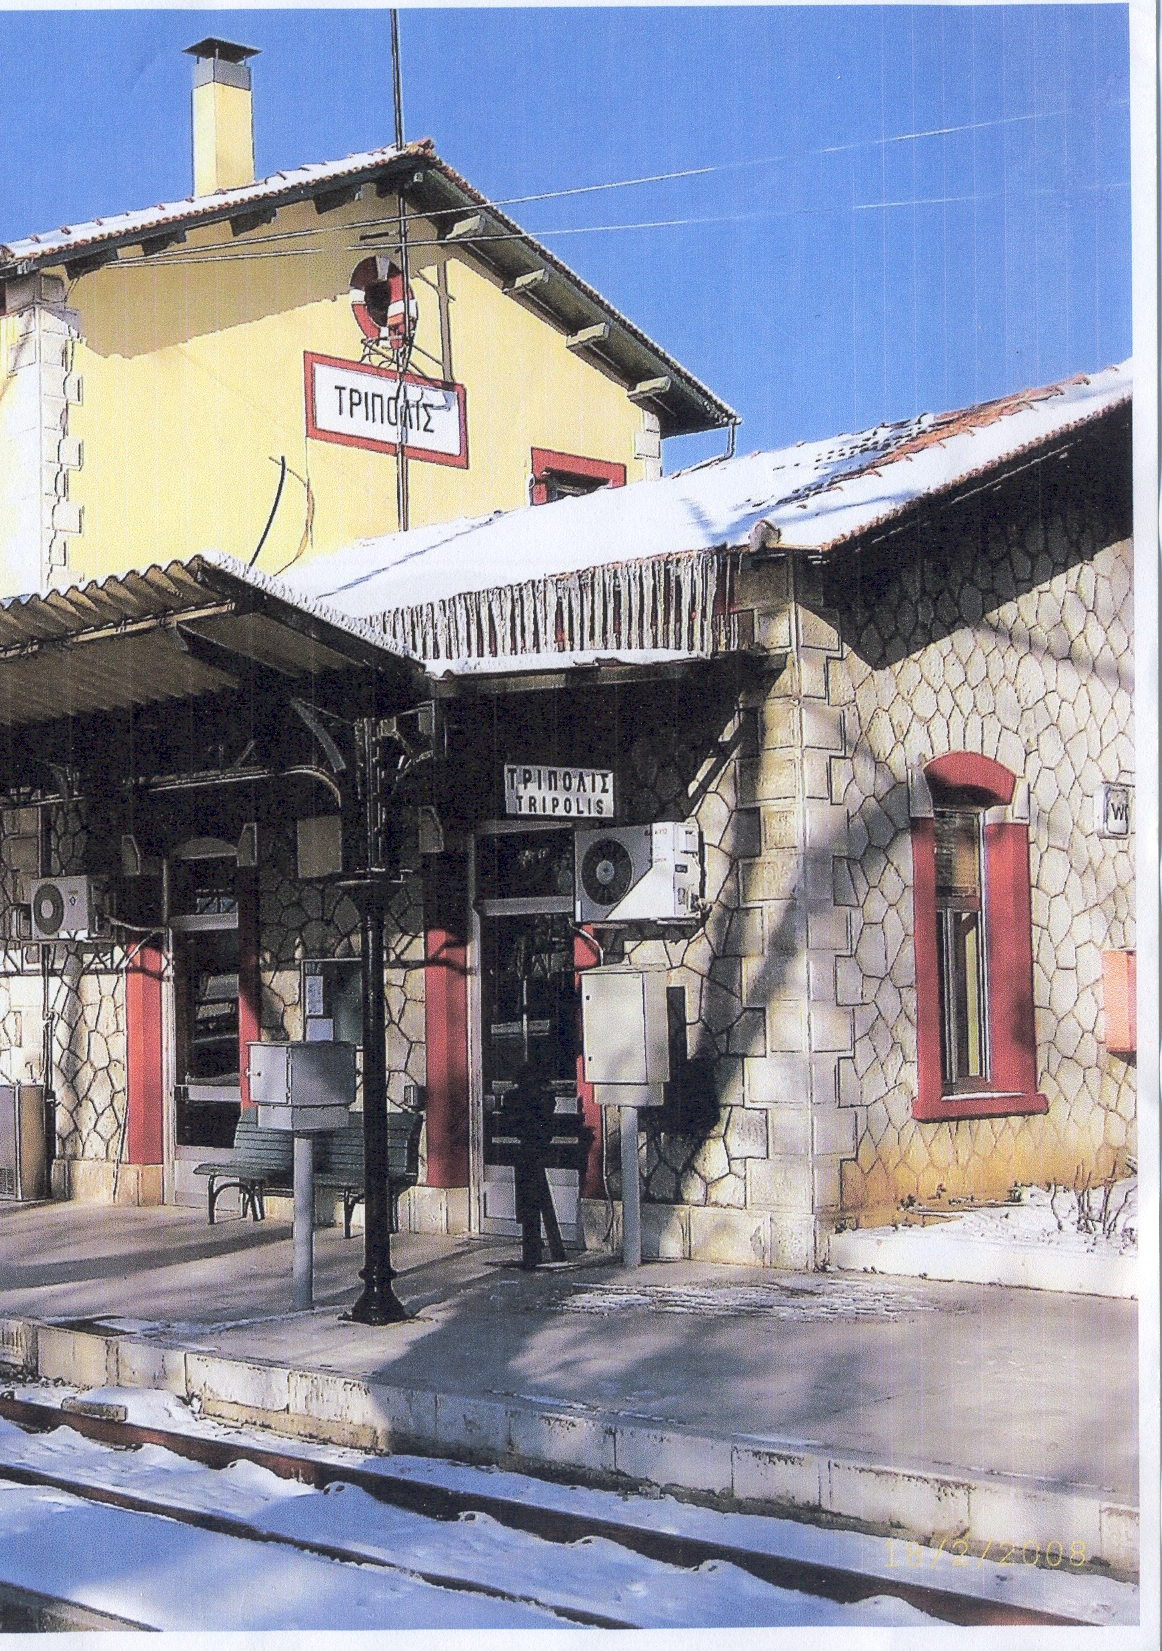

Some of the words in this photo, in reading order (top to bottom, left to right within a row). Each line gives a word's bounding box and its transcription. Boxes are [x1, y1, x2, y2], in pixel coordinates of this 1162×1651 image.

[335, 385, 434, 433] ΤΡΙΠΟΛΙΣ
[507, 768, 609, 793] ΤΡΙΠΟΛΙΣ
[516, 795, 604, 815] TRIPOLIS
